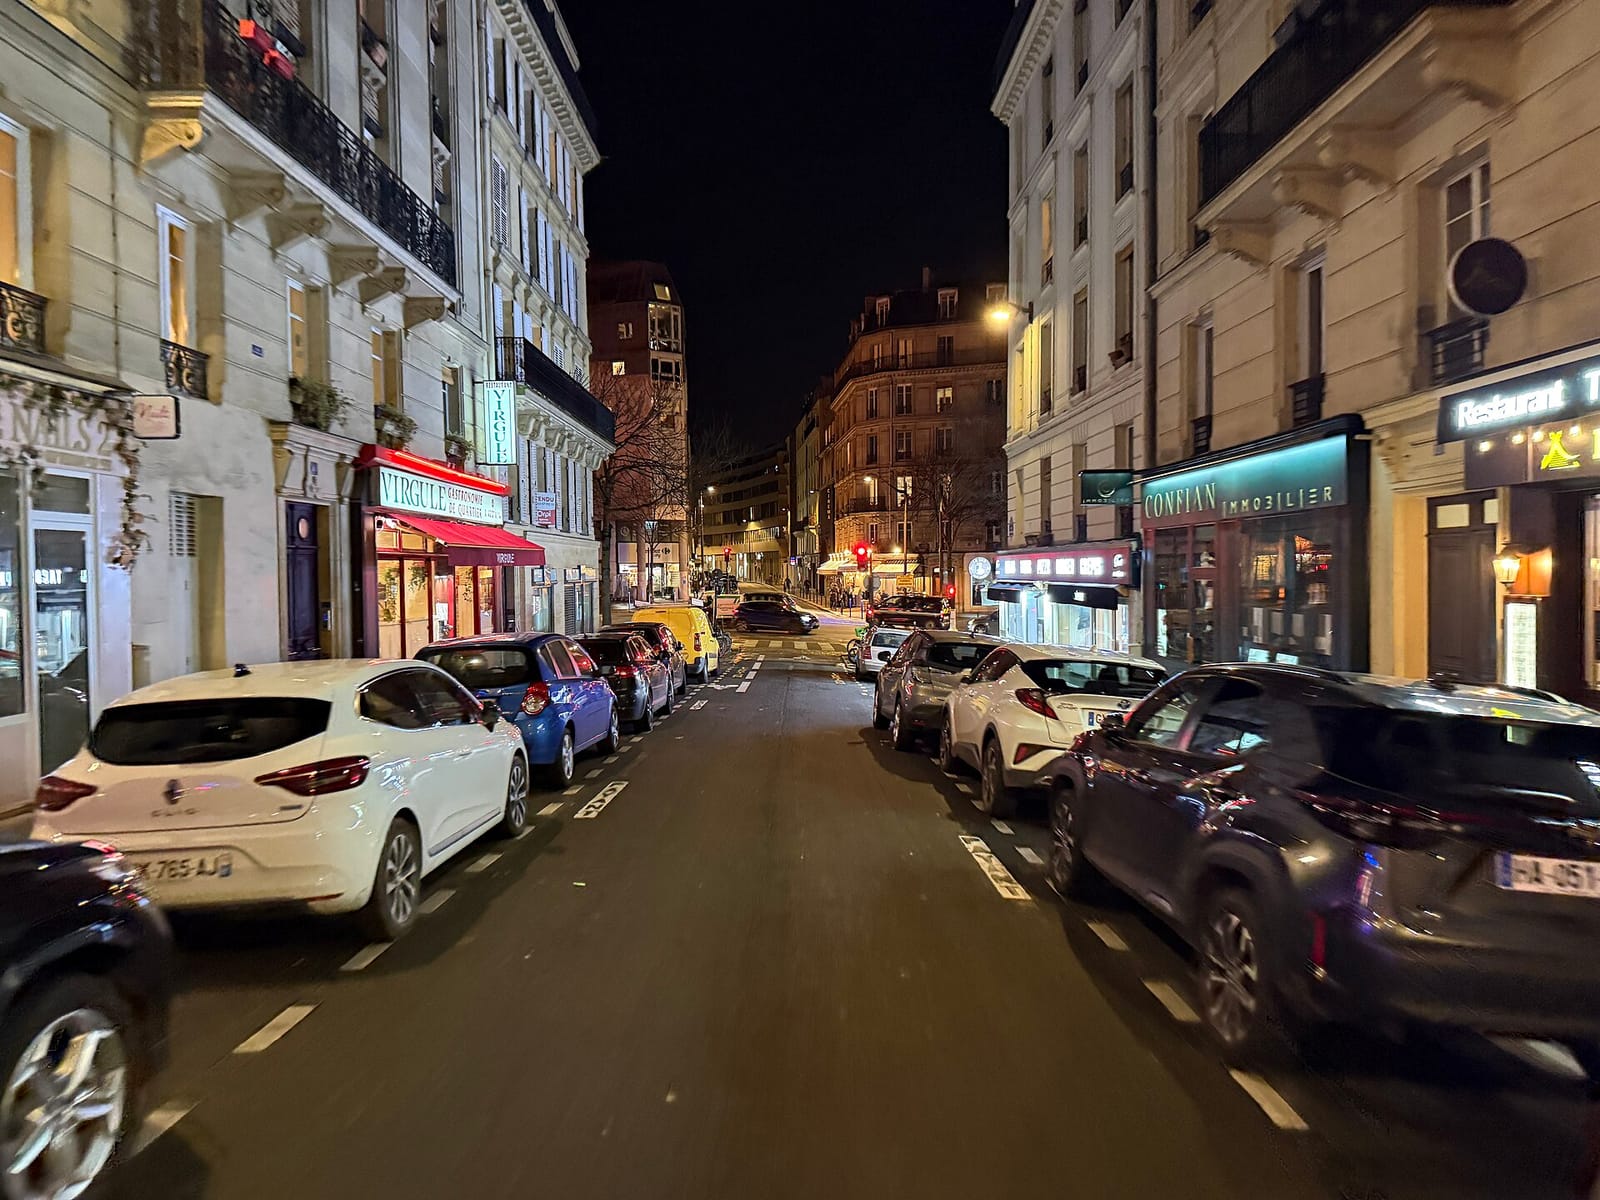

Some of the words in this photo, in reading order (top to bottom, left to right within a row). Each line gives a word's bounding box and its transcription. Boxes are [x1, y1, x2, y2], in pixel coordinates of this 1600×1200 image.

[1456, 379, 1565, 428] Restaurant
[494, 389, 507, 464] VIRGULE
[381, 471, 447, 512] VIRGULE
[447, 487, 483, 506] GASTRONOMIE
[1144, 482, 1216, 519] CONFIAN
[1222, 486, 1332, 518] IMMOBILIER
[449, 502, 456, 514] DE
[458, 503, 483, 519] QUARTIER
[537, 510, 552, 520] Orpi
